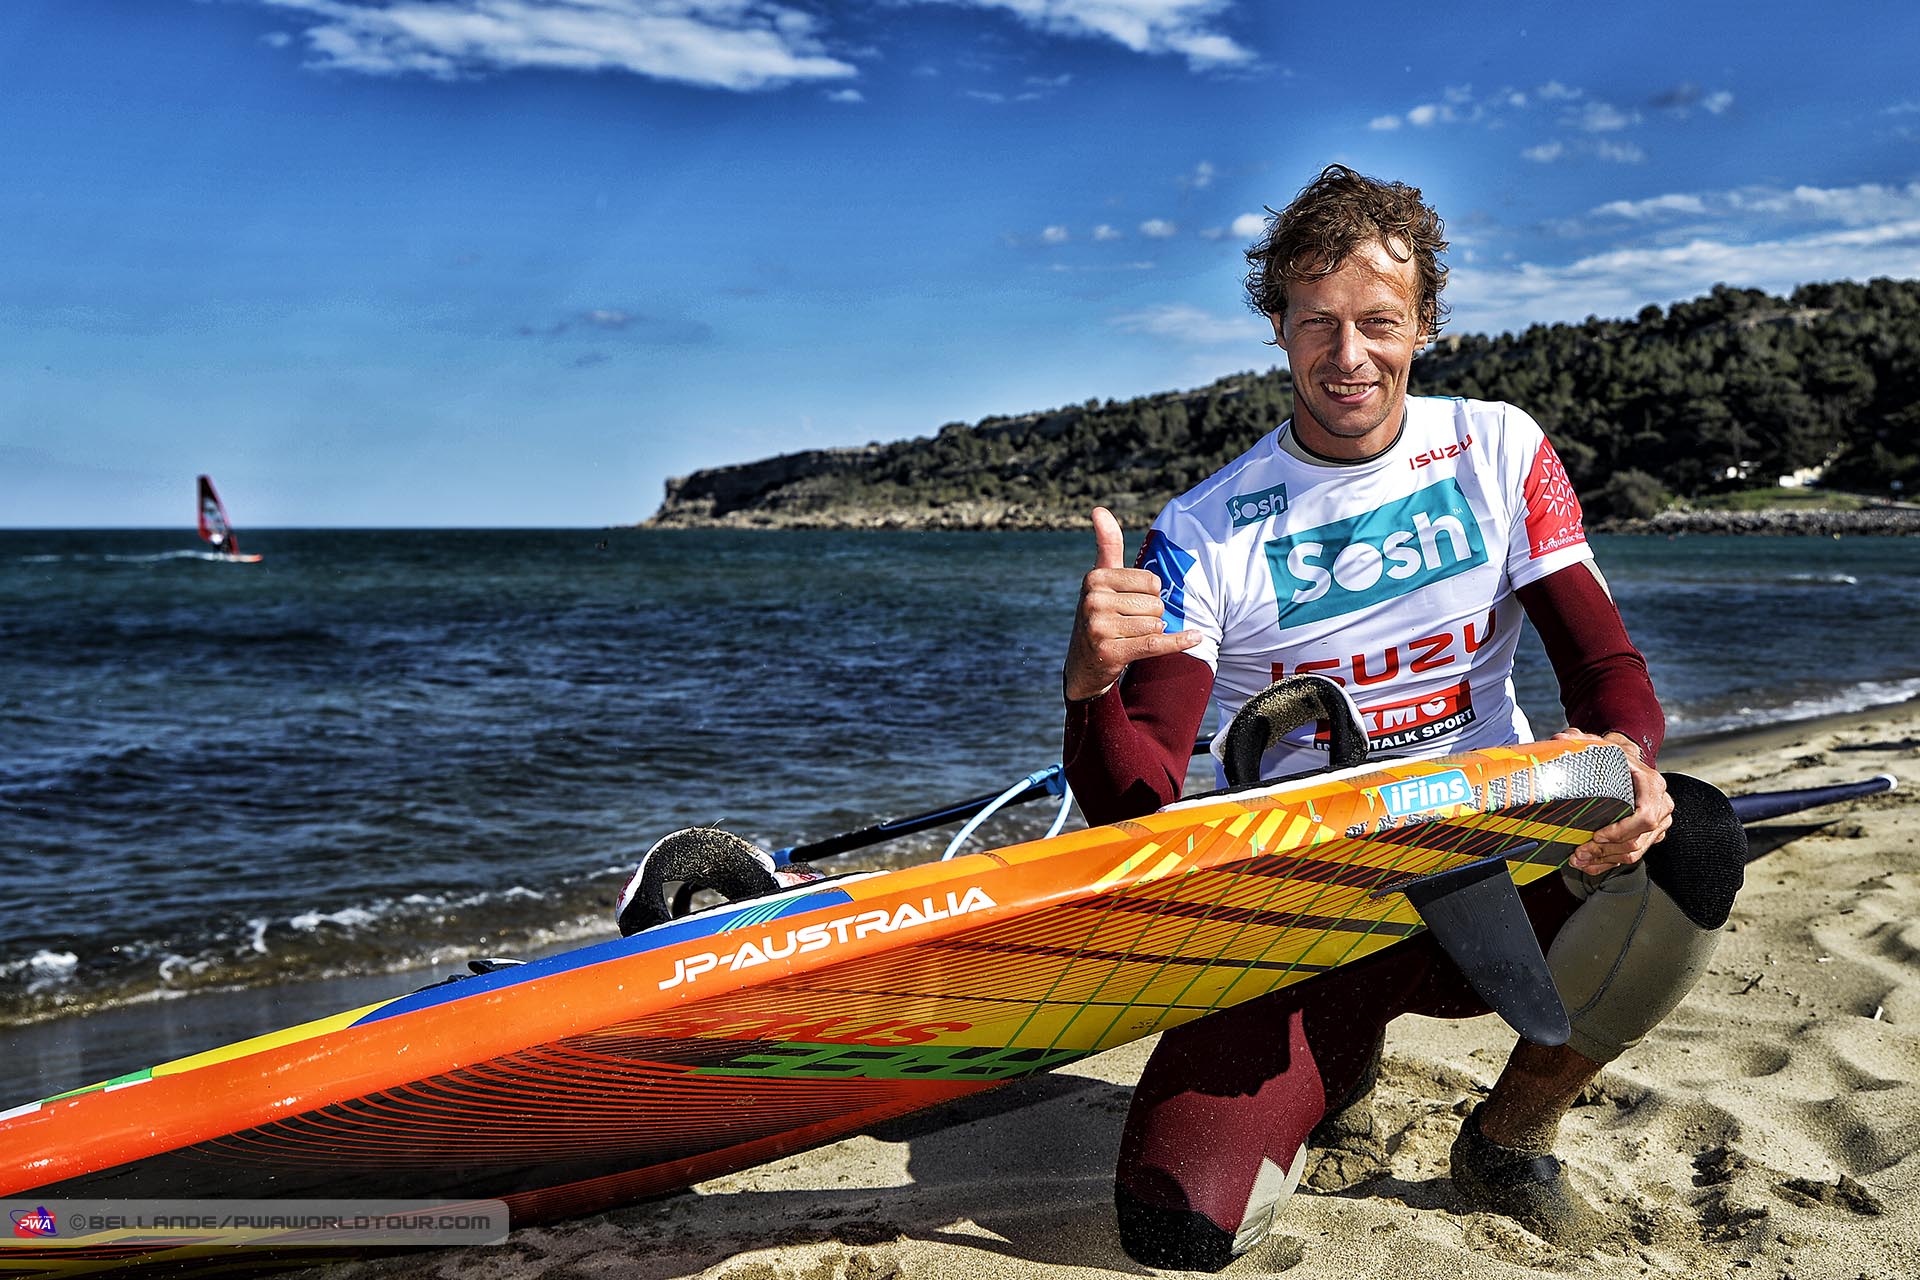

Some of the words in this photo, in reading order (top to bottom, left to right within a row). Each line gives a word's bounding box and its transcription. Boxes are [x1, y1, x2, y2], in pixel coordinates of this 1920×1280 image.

[1409, 434, 1473, 470] ISUZU
[1232, 494, 1285, 520] Sosh
[1287, 511, 1472, 604] Sosh
[1271, 608, 1497, 687] ISUZU
[1370, 732, 1419, 750] TALK
[1422, 709, 1473, 738] SPORT
[1390, 777, 1465, 813] iFins
[658, 886, 999, 990] JP-AUSTRALIA
